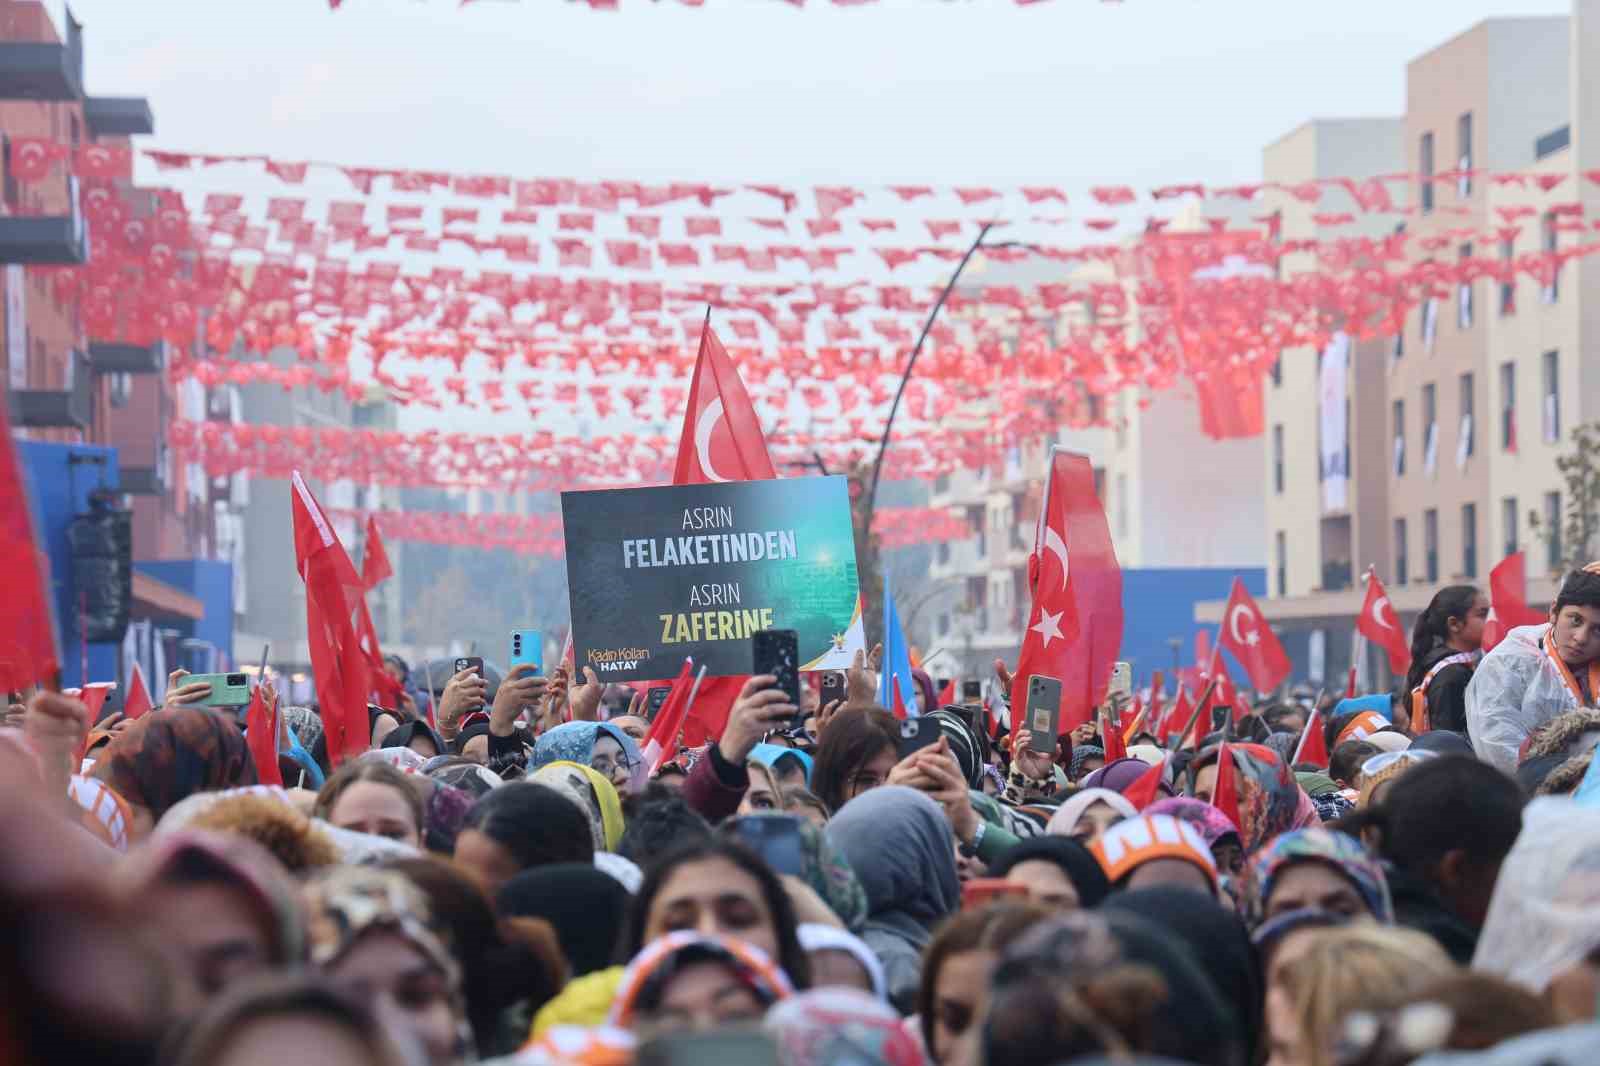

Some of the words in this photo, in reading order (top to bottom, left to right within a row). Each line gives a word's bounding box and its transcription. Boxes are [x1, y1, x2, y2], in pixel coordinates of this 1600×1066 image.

[682, 506, 733, 530] ASRIN
[690, 582, 741, 607] ASRIN
[600, 660, 638, 672] HATAY
